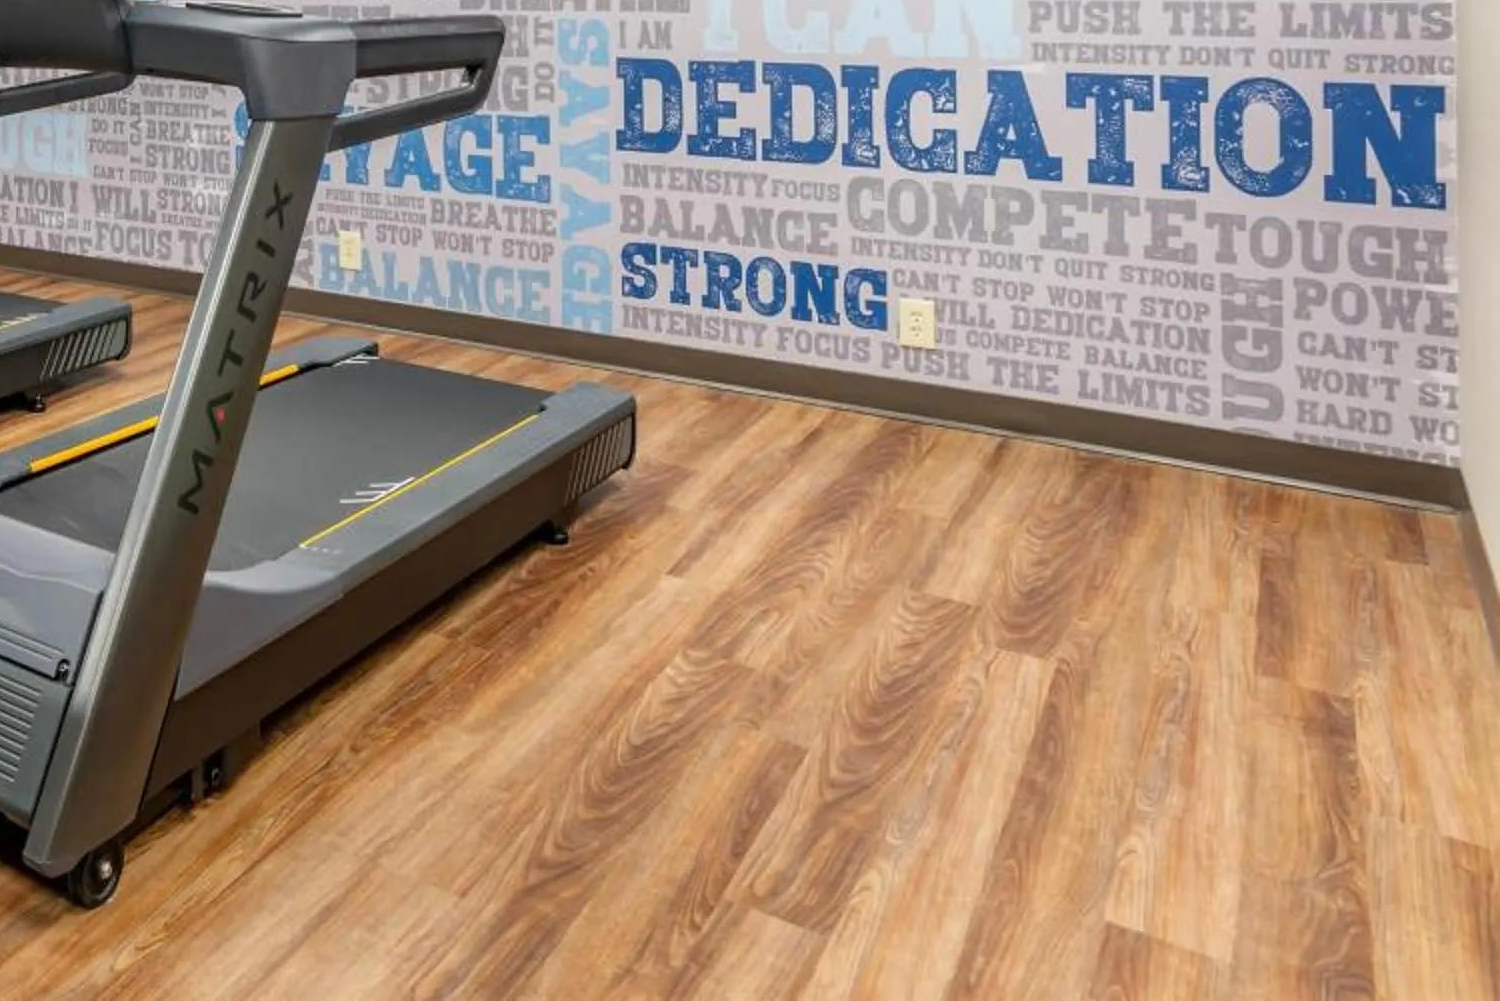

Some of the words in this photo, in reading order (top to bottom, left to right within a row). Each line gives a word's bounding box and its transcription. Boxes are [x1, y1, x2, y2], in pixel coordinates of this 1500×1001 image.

[636, 20, 673, 50] AM
[1028, 0, 1142, 35] PUSH
[1162, 1, 1256, 37] THE
[1279, 1, 1455, 41] LIMITS
[1031, 42, 1171, 66] INTENSITY
[1179, 45, 1256, 68] DON'T
[1267, 47, 1331, 70] QUIT
[1344, 53, 1456, 75] STRONG
[615, 56, 1448, 210] DEDICATION
[145, 144, 231, 175] STRONG
[558, 18, 613, 334] SAVAGE
[623, 161, 768, 199] INTENSITY
[772, 177, 841, 204] FOCUS
[95, 221, 172, 263] FOCUS
[430, 197, 557, 237] BREATHE
[619, 193, 838, 257] BALANCE
[847, 173, 1196, 264] COMPETE
[375, 222, 423, 248] STOP
[501, 237, 554, 264] STOP
[851, 236, 972, 268] INTENSITY
[979, 248, 1044, 275] DON'T
[1054, 256, 1108, 282] QUIT
[1120, 262, 1216, 294] STRONG
[1204, 211, 1449, 286] TOUGH
[620, 239, 888, 332] STRONG
[892, 268, 960, 295] CAN'T
[972, 276, 1034, 303] STOP
[1048, 285, 1127, 314] WON'T
[1139, 295, 1212, 324] STOP
[1293, 277, 1461, 339] POWE
[177, 181, 294, 515] MATRIX
[622, 304, 768, 349] INTENSITY
[776, 325, 871, 363] FOCUS
[966, 330, 1070, 362] COMPETE
[1085, 346, 1208, 381] BALANCE
[1012, 305, 1212, 356] DEDICATION
[1220, 272, 1285, 432] UGH
[1298, 331, 1398, 366] CAN'T
[881, 341, 969, 382] PUSH
[987, 356, 1058, 395] THE
[1077, 368, 1210, 418] LIMITS
[1296, 367, 1400, 403] WON'T
[1296, 399, 1393, 437] HARD
